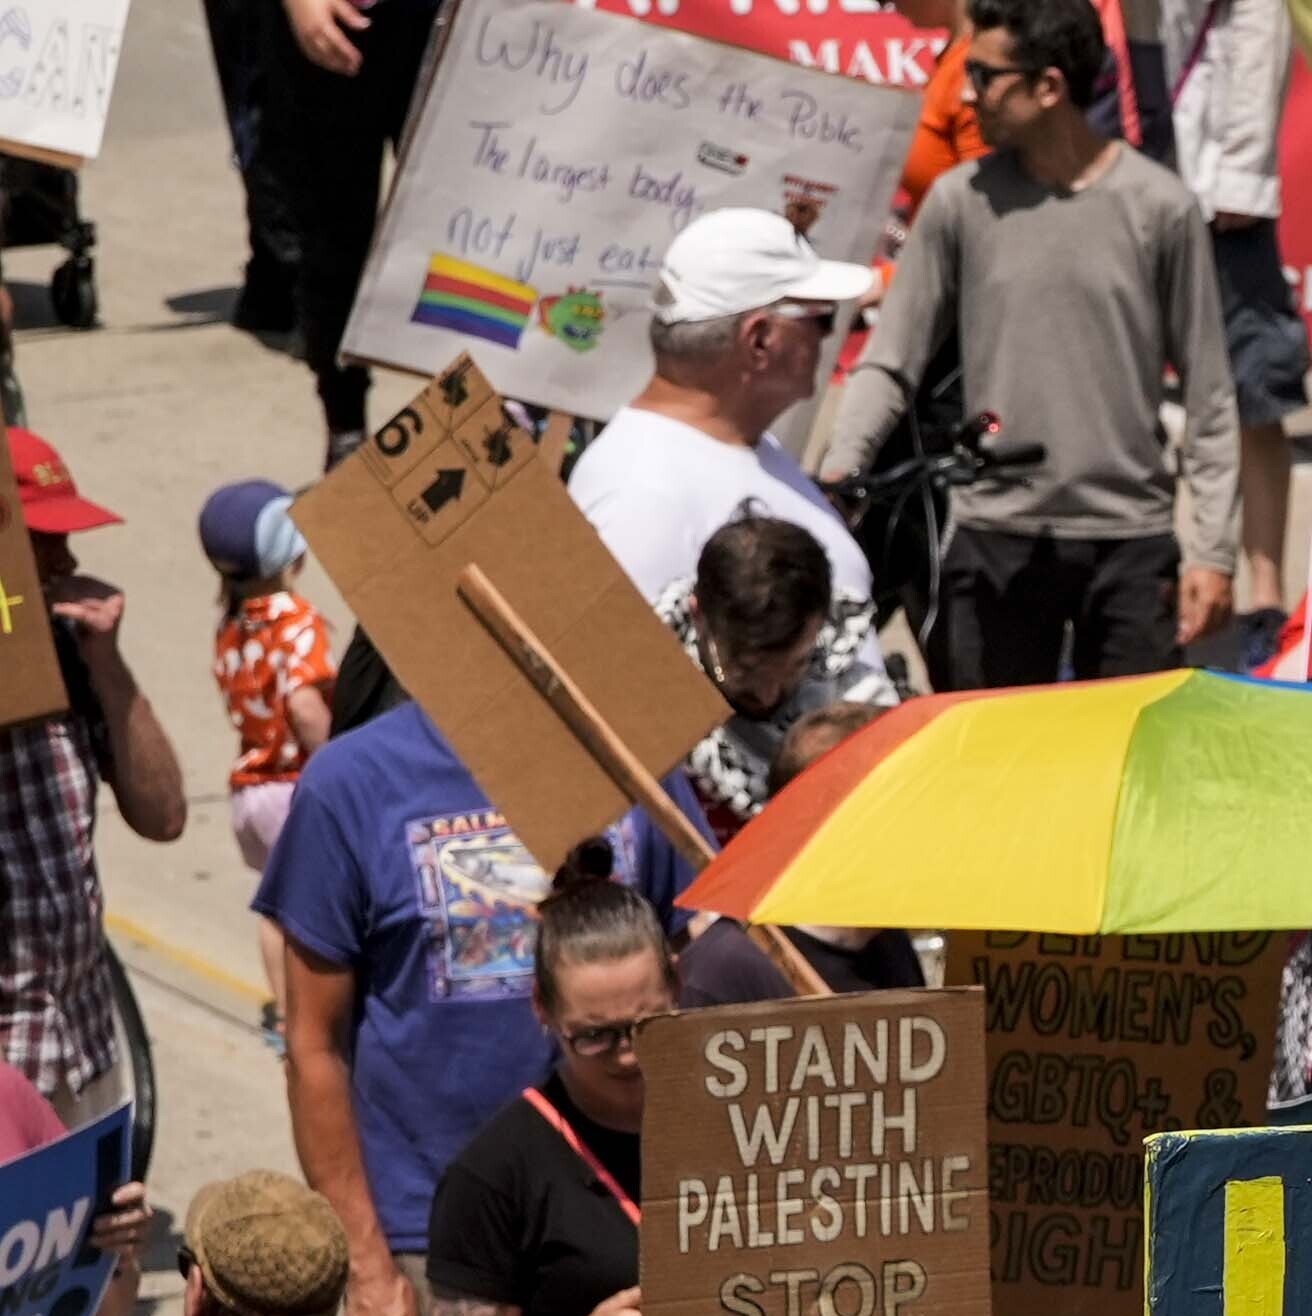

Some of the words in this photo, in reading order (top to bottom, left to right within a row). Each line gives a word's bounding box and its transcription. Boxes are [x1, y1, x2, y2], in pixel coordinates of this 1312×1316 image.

[475, 14, 588, 116] Why
[615, 51, 691, 109] does
[717, 83, 763, 118] the
[470, 120, 508, 171] The
[515, 129, 611, 196] largest
[447, 208, 517, 259] not
[517, 231, 583, 283] just
[704, 1015, 948, 1099] STAND
[727, 1089, 919, 1168] WITH
[677, 1154, 971, 1254] PALESTINE
